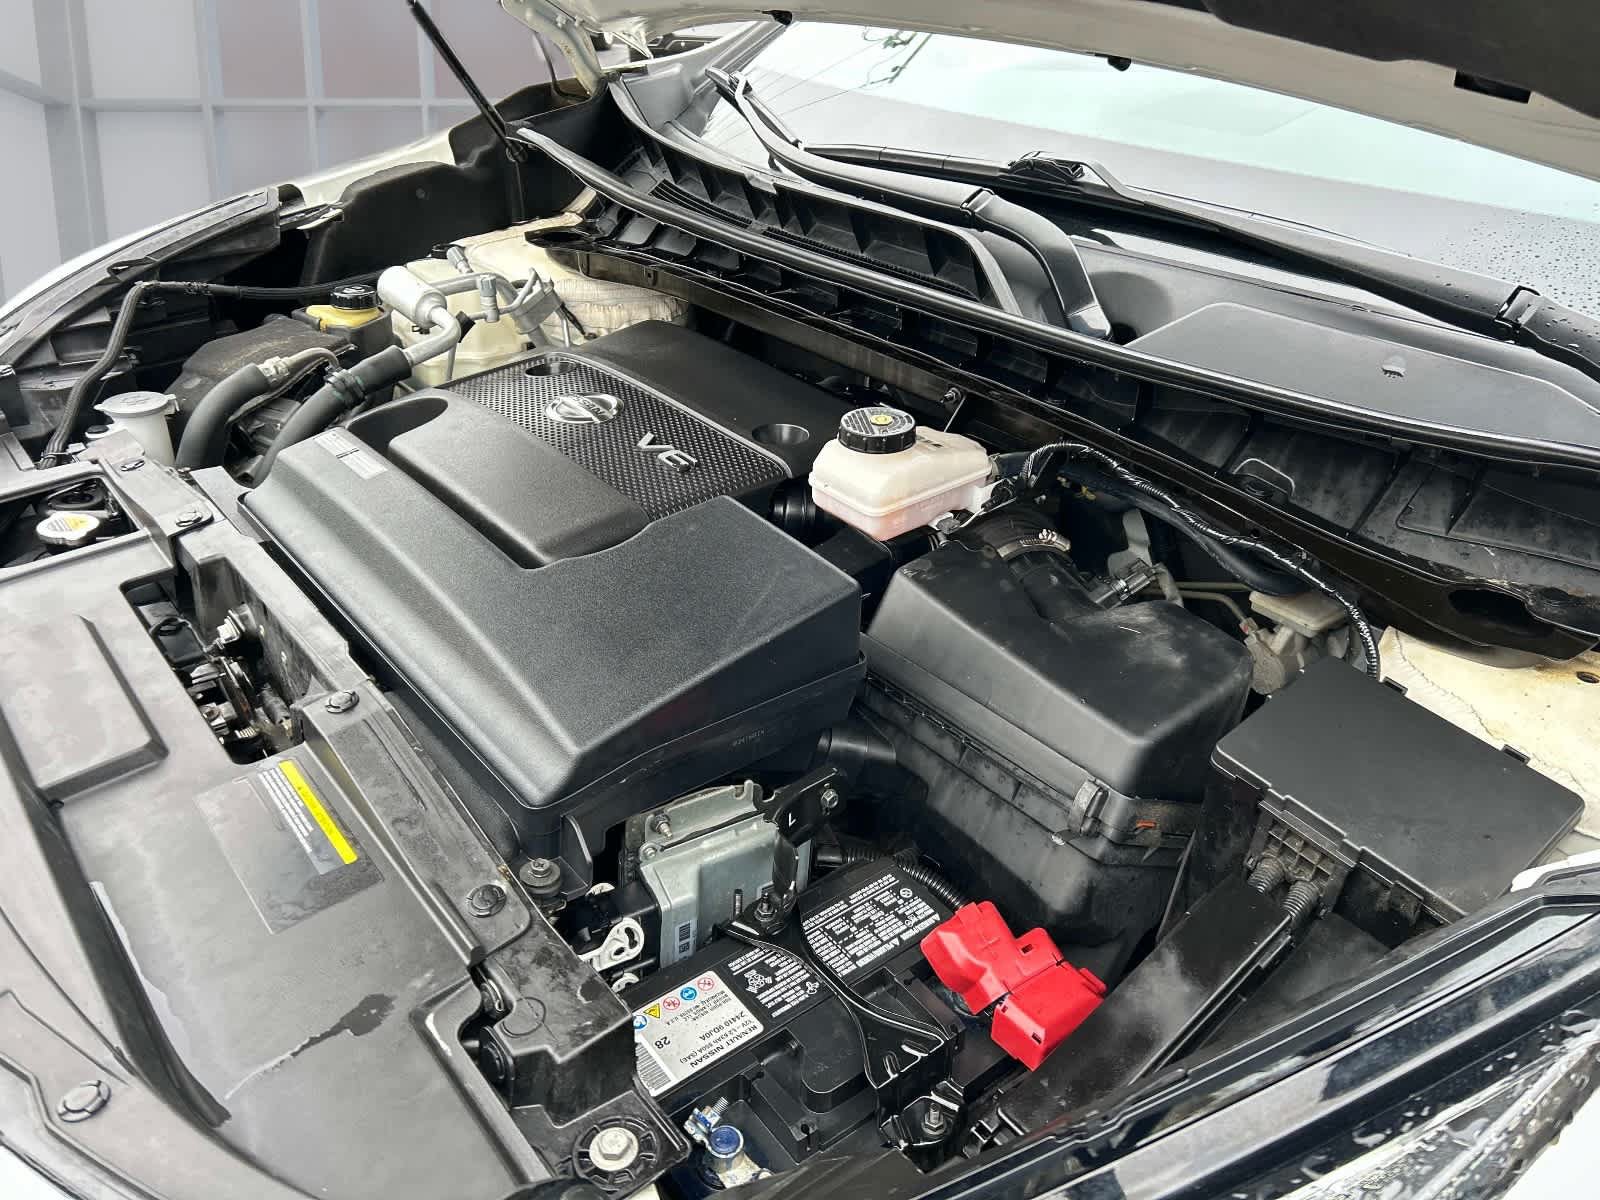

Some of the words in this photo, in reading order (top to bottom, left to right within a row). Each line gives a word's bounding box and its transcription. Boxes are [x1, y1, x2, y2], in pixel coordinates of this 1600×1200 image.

[635, 430, 699, 473] V6
[653, 1036, 671, 1049] 28
[724, 1024, 757, 1046] RENAULT
[689, 1045, 724, 1067] NISSAN
